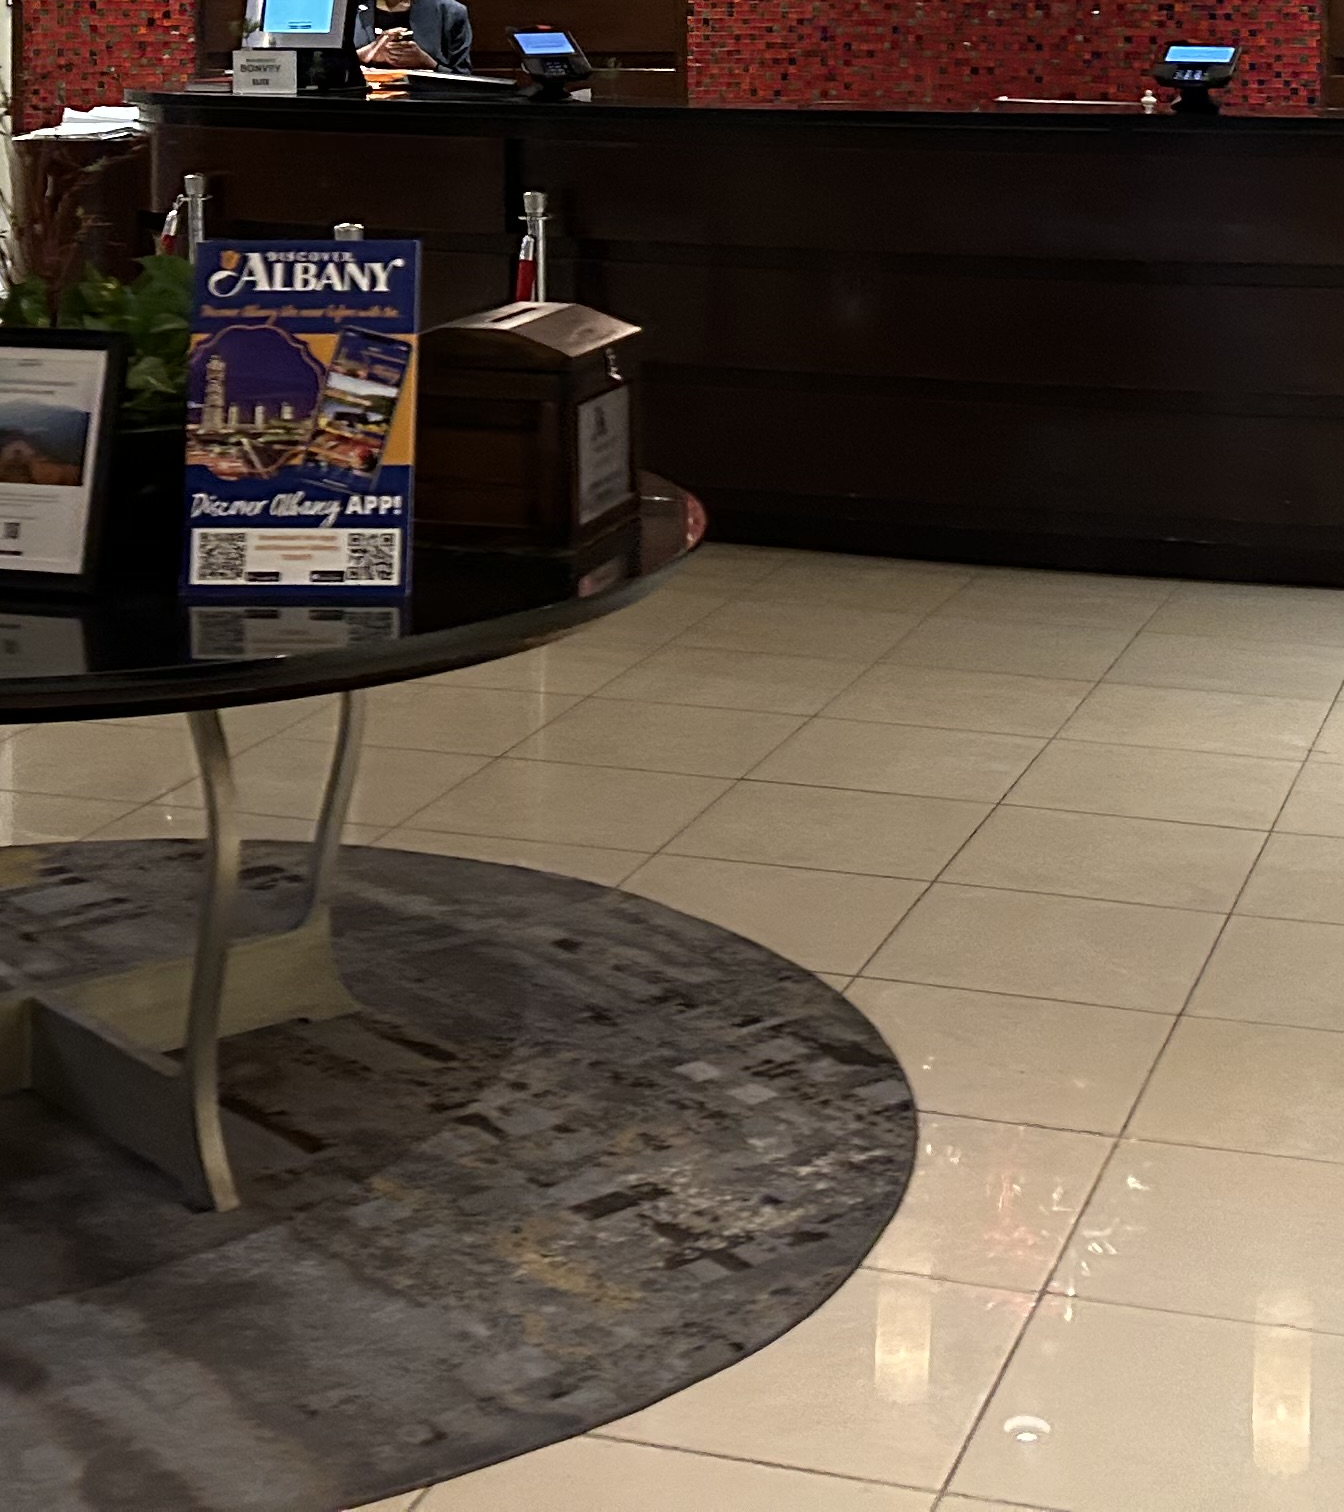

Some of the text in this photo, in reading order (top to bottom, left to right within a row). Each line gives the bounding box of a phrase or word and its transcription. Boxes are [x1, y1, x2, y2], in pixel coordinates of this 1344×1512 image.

[208, 252, 405, 298] ALBANY
[265, 251, 355, 262] DISCOVER
[190, 491, 403, 528] Discover Albany APP!
